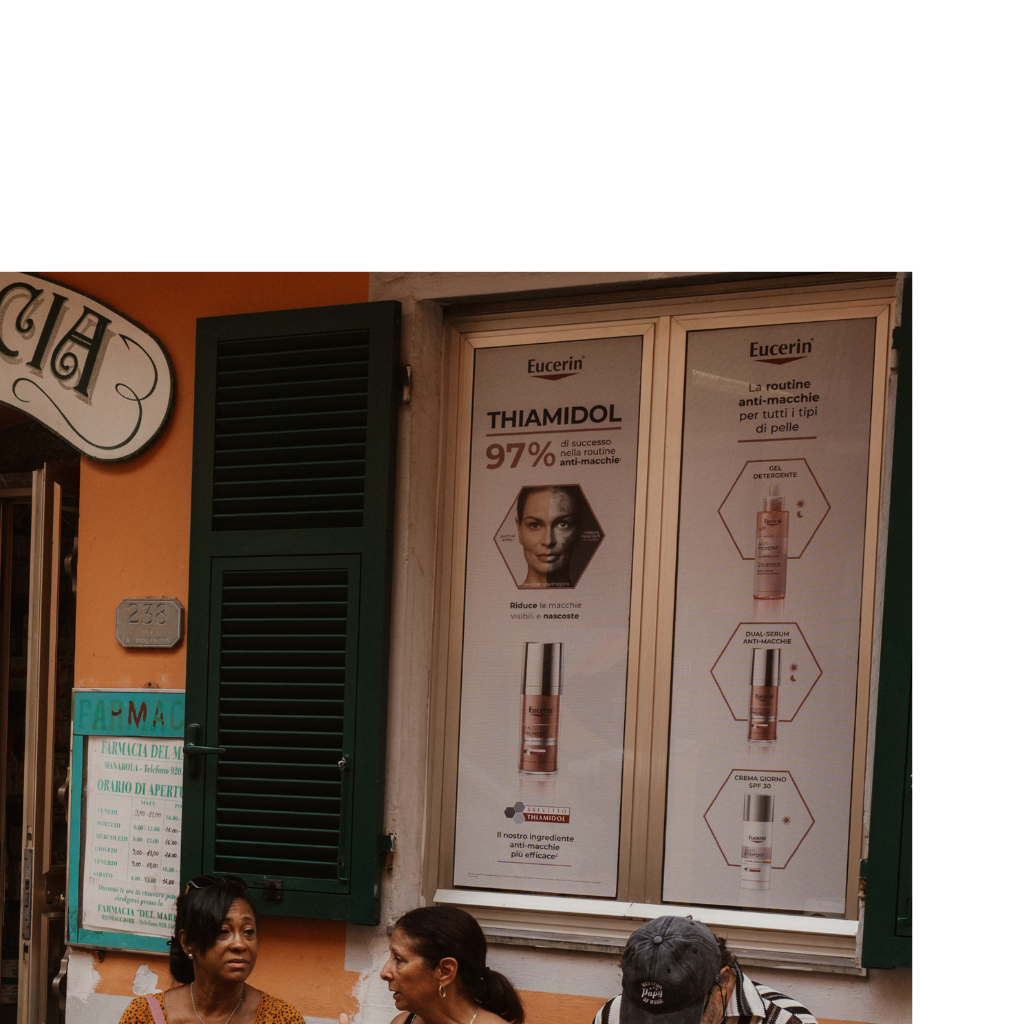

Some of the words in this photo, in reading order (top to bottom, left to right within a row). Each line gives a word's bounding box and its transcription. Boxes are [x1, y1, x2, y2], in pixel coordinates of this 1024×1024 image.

[750, 339, 813, 357] Eucerin
[527, 356, 583, 373] Eucerin
[748, 383, 762, 393] La
[766, 380, 811, 391] routine
[738, 392, 820, 407] anti-macchie
[487, 404, 622, 429] THIAMIDOL
[739, 411, 758, 422] per
[763, 408, 788, 420] tutti
[798, 406, 818, 418] tipi
[755, 423, 767, 434] di
[771, 422, 799, 434] pelle
[560, 440, 570, 448] di
[572, 439, 612, 447] successo
[485, 441, 556, 470] 97%
[560, 449, 581, 457] nella
[584, 447, 616, 456] routine
[753, 472, 798, 480] DETERGENTE
[510, 602, 538, 610] Riduce
[548, 601, 582, 609] macchie
[128, 603, 167, 625] 238
[78, 699, 184, 731] FARMAC
[101, 741, 148, 758] FARMACIA
[150, 744, 171, 760] DEL
[105, 761, 138, 772] MANAROLA
[144, 764, 170, 774] Telefono
[97, 779, 133, 794] ORARIO
[134, 782, 147, 796] DI
[148, 783, 183, 799] APERTU
[527, 814, 566, 822] THIAMIDOL
[529, 832, 574, 843] ingrediente
[510, 842, 560, 851] anti-macchie
[511, 851, 523, 859] più
[97, 904, 135, 916] FARMACIA
[641, 988, 663, 999] Papy
